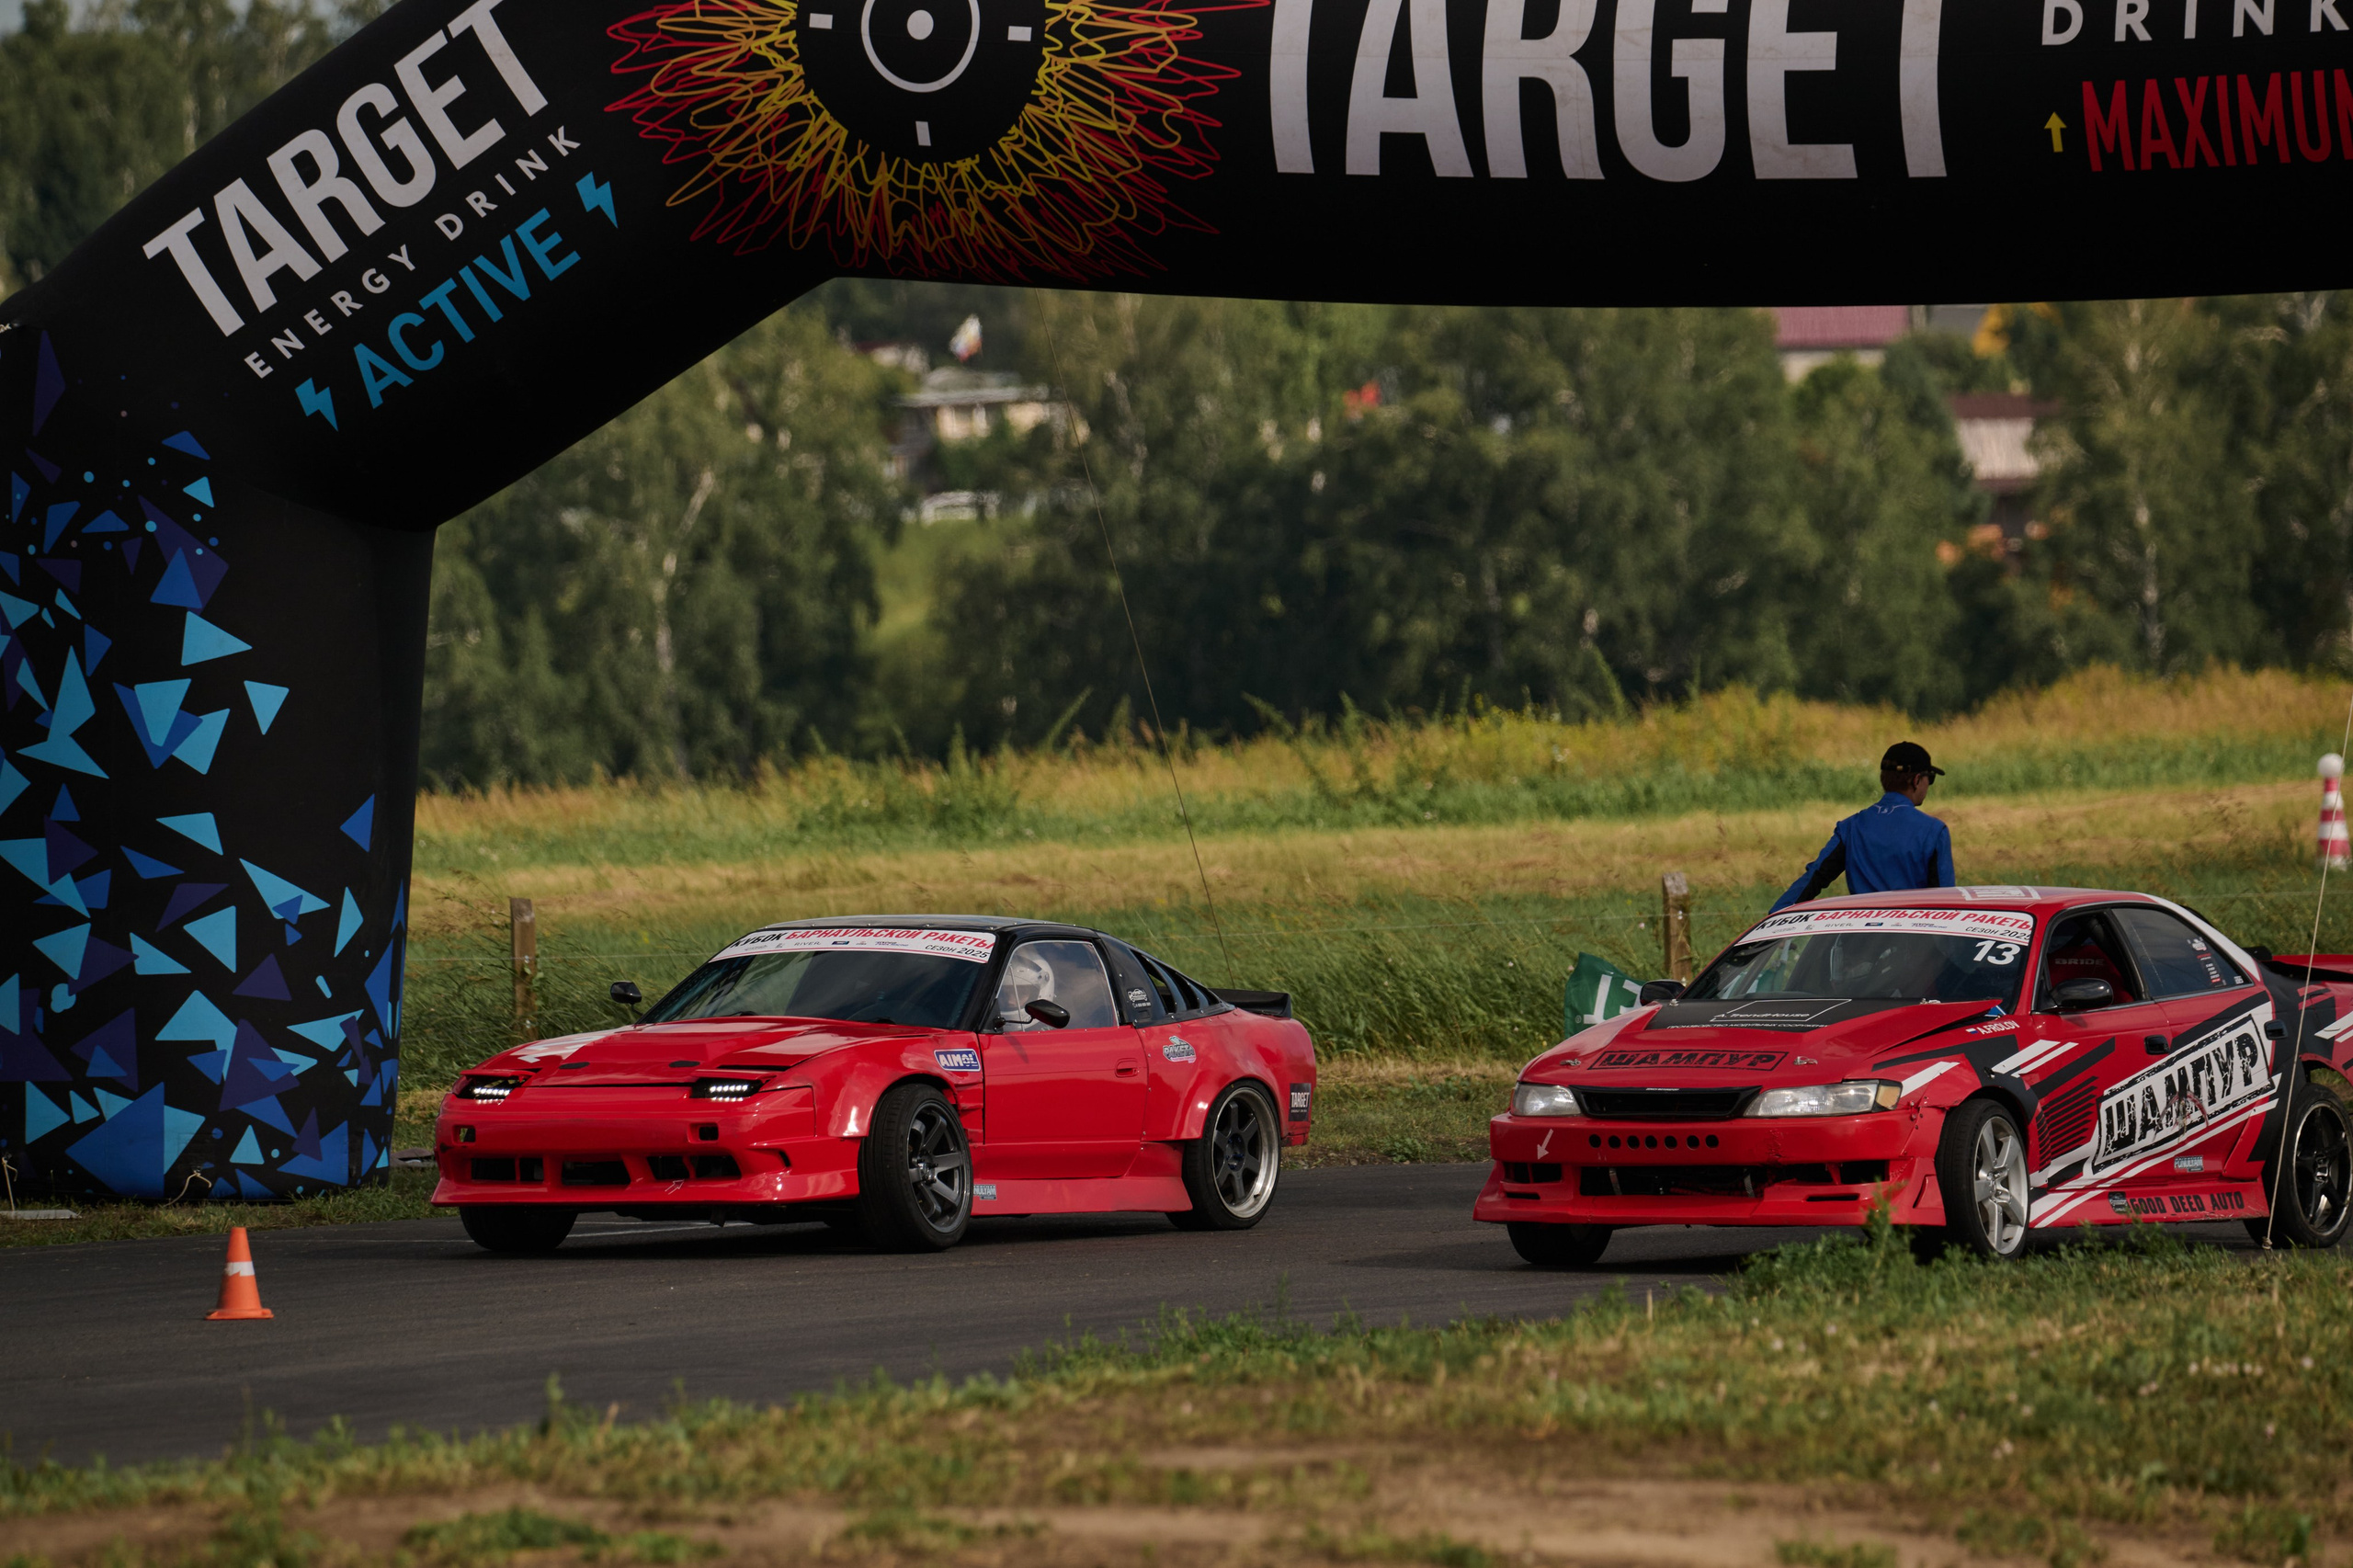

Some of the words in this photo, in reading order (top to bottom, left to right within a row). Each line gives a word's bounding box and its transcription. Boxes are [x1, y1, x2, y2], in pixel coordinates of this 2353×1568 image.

[2041, 0, 2349, 46] DRINK
[142, 0, 548, 336] TARGET
[244, 244, 417, 379] ENERGY
[434, 126, 581, 241] DRINK
[353, 207, 581, 409] ACTIVE
[1756, 913, 1816, 931] КУБОК
[1813, 909, 1961, 921] БАРНАУЛЬСКОЙ
[1965, 926, 1999, 935] СЕЗОН
[730, 932, 788, 949] КУБОК
[785, 928, 925, 939] БАРНАУЛЬСКОЙ
[922, 931, 995, 949] РАКЕТЫ
[958, 948, 990, 959] 2025
[1973, 940, 2021, 965] 13
[938, 1053, 977, 1067] AIMOL
[1599, 1052, 1777, 1067] ШАМПУР
[2102, 1032, 2258, 1157] ШАМПУР
[2131, 1197, 2166, 1214] GOOD
[2170, 1195, 2205, 1212] DEED
[2211, 1191, 2245, 1210] AUTO
